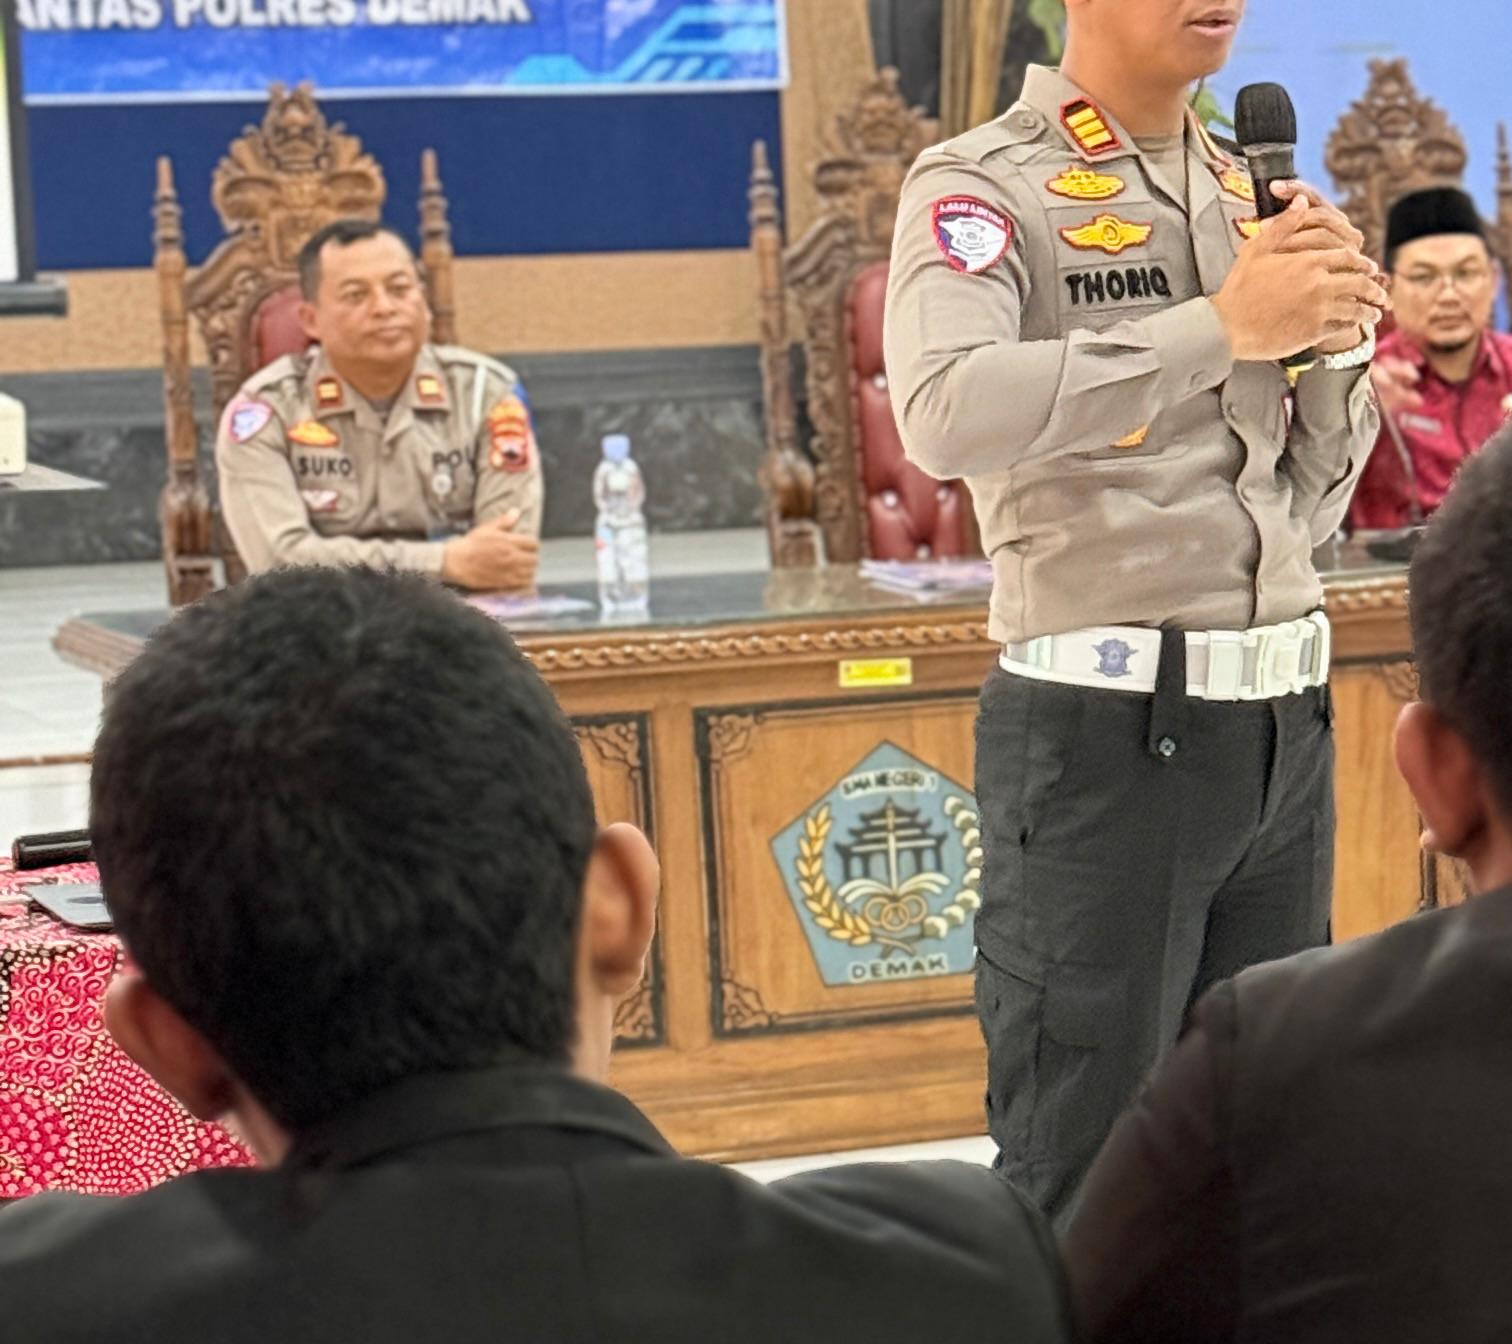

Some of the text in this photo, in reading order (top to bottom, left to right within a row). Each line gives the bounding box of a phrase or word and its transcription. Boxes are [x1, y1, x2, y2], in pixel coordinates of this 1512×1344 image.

[1064, 265, 1173, 305] THORIQ
[298, 455, 353, 477] SUKO
[851, 956, 946, 979] DEMAK
